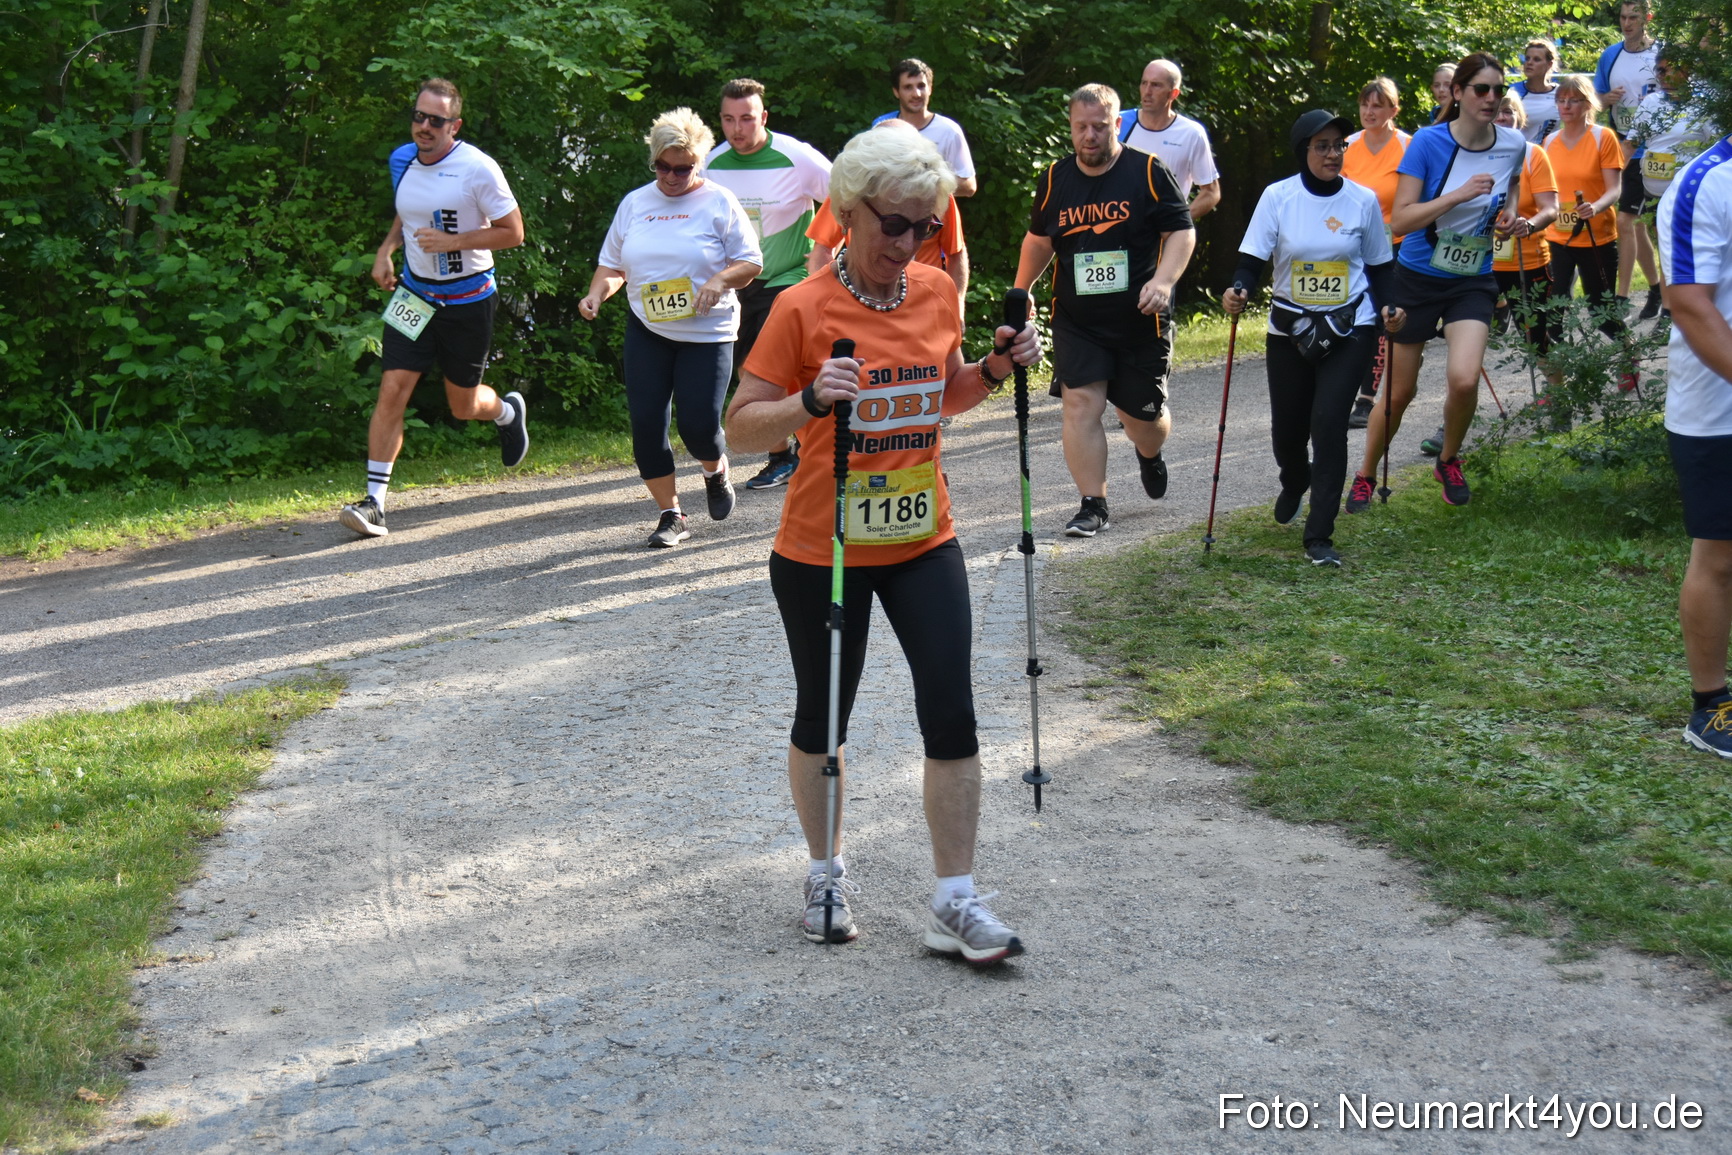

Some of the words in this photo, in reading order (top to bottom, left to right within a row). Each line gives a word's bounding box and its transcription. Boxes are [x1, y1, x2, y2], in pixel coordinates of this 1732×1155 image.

[1647, 161, 1666, 172] 934
[1059, 210, 1068, 227] BIT
[1067, 201, 1130, 225] WINGS
[441, 209, 463, 274] HUER
[1442, 245, 1479, 266] 1051
[1085, 266, 1117, 283] 288
[1297, 276, 1341, 292] 1342
[648, 293, 688, 312] 1145
[391, 301, 422, 327] 1058
[1372, 336, 1387, 391] adidas
[868, 368, 893, 386] 30
[896, 364, 938, 382] Jahre
[856, 390, 943, 423] OBI
[860, 484, 902, 494] firmenlauf
[857, 491, 928, 525] 1186
[866, 525, 888, 533] Soier
[888, 521, 922, 532] Charlotte
